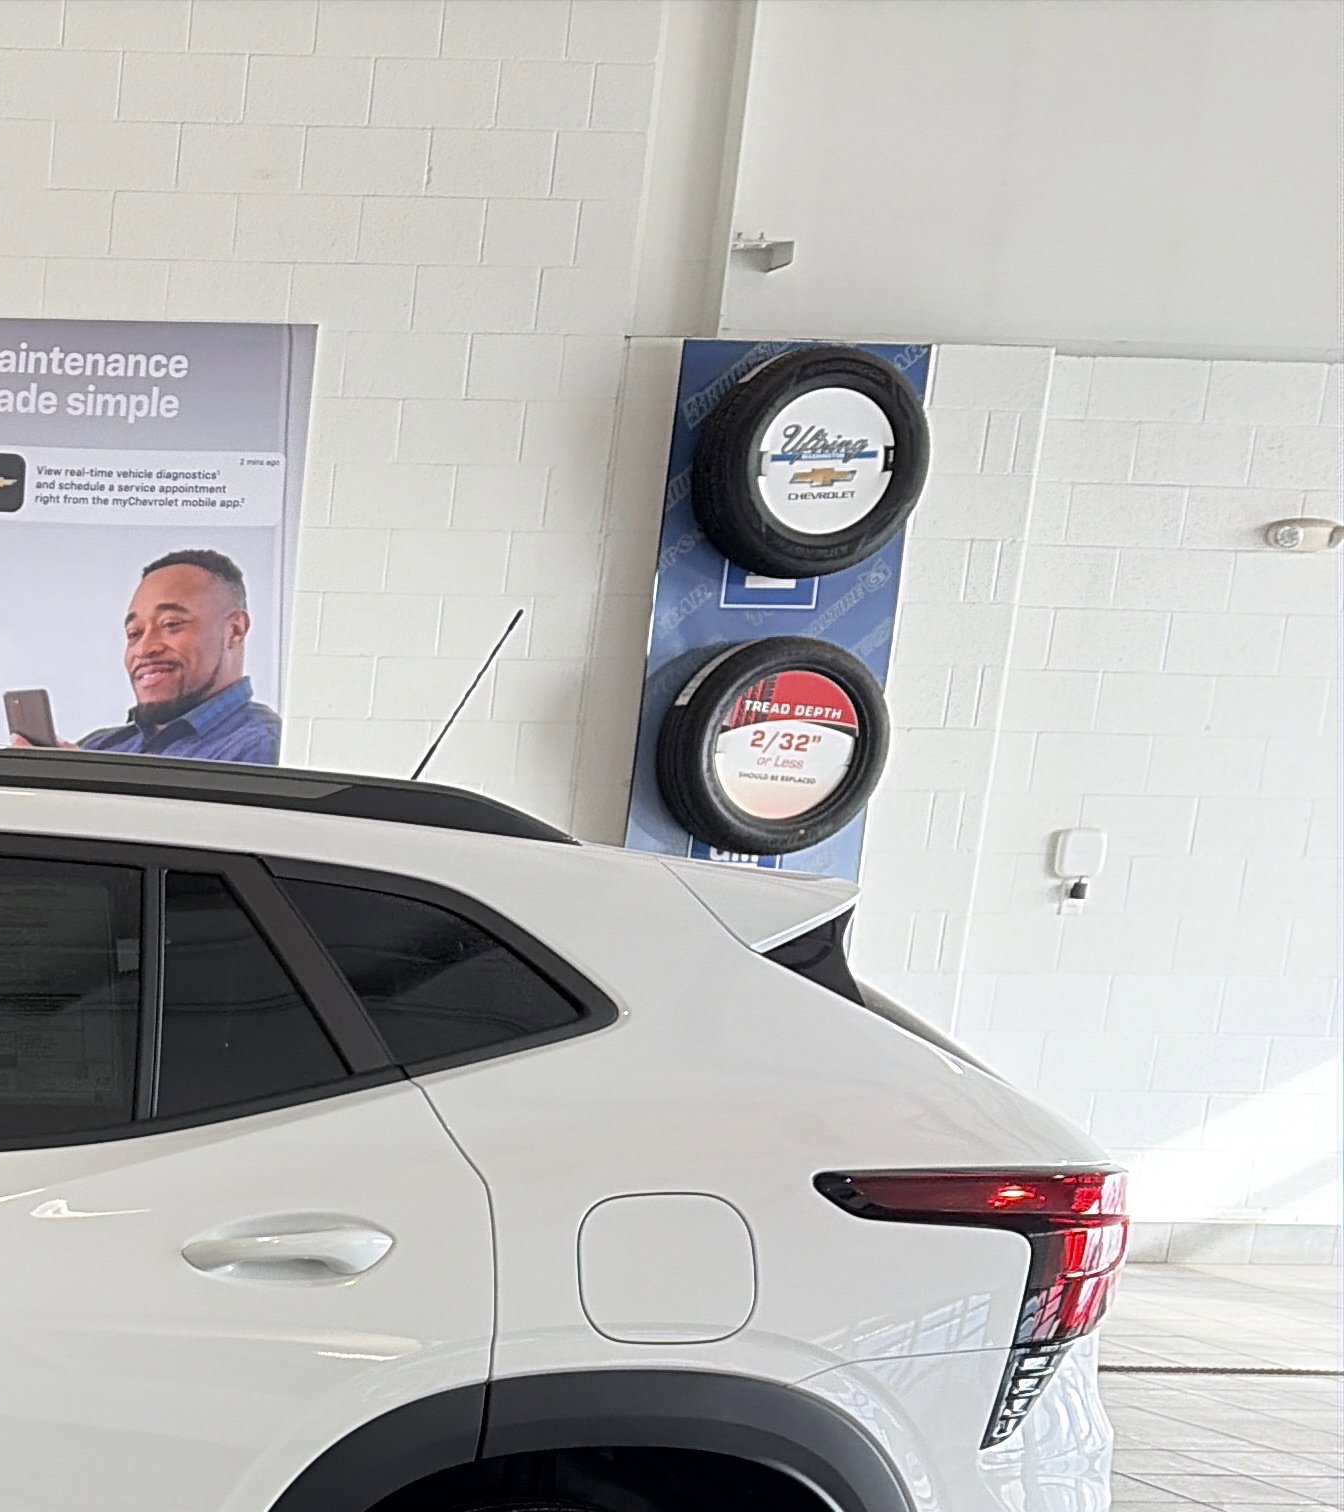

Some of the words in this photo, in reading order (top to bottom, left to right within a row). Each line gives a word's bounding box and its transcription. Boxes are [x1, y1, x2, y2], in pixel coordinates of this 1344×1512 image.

[66, 384, 180, 424] simple
[36, 465, 61, 477] View
[65, 467, 113, 478] real-time
[116, 468, 152, 479] vehicle
[36, 480, 55, 490] and
[59, 481, 105, 491] schedule
[109, 483, 115, 491] a
[118, 482, 155, 492] service
[159, 483, 226, 496] appointment
[788, 491, 855, 500] CHEVROLET
[35, 493, 61, 505] right
[64, 495, 88, 504] from
[92, 495, 109, 504] the
[112, 496, 178, 508] myChevrolet
[182, 497, 216, 507] mobile
[744, 700, 790, 715] TREAD
[795, 705, 842, 720] DEPTH
[757, 756, 771, 767] or
[774, 756, 803, 769] Less
